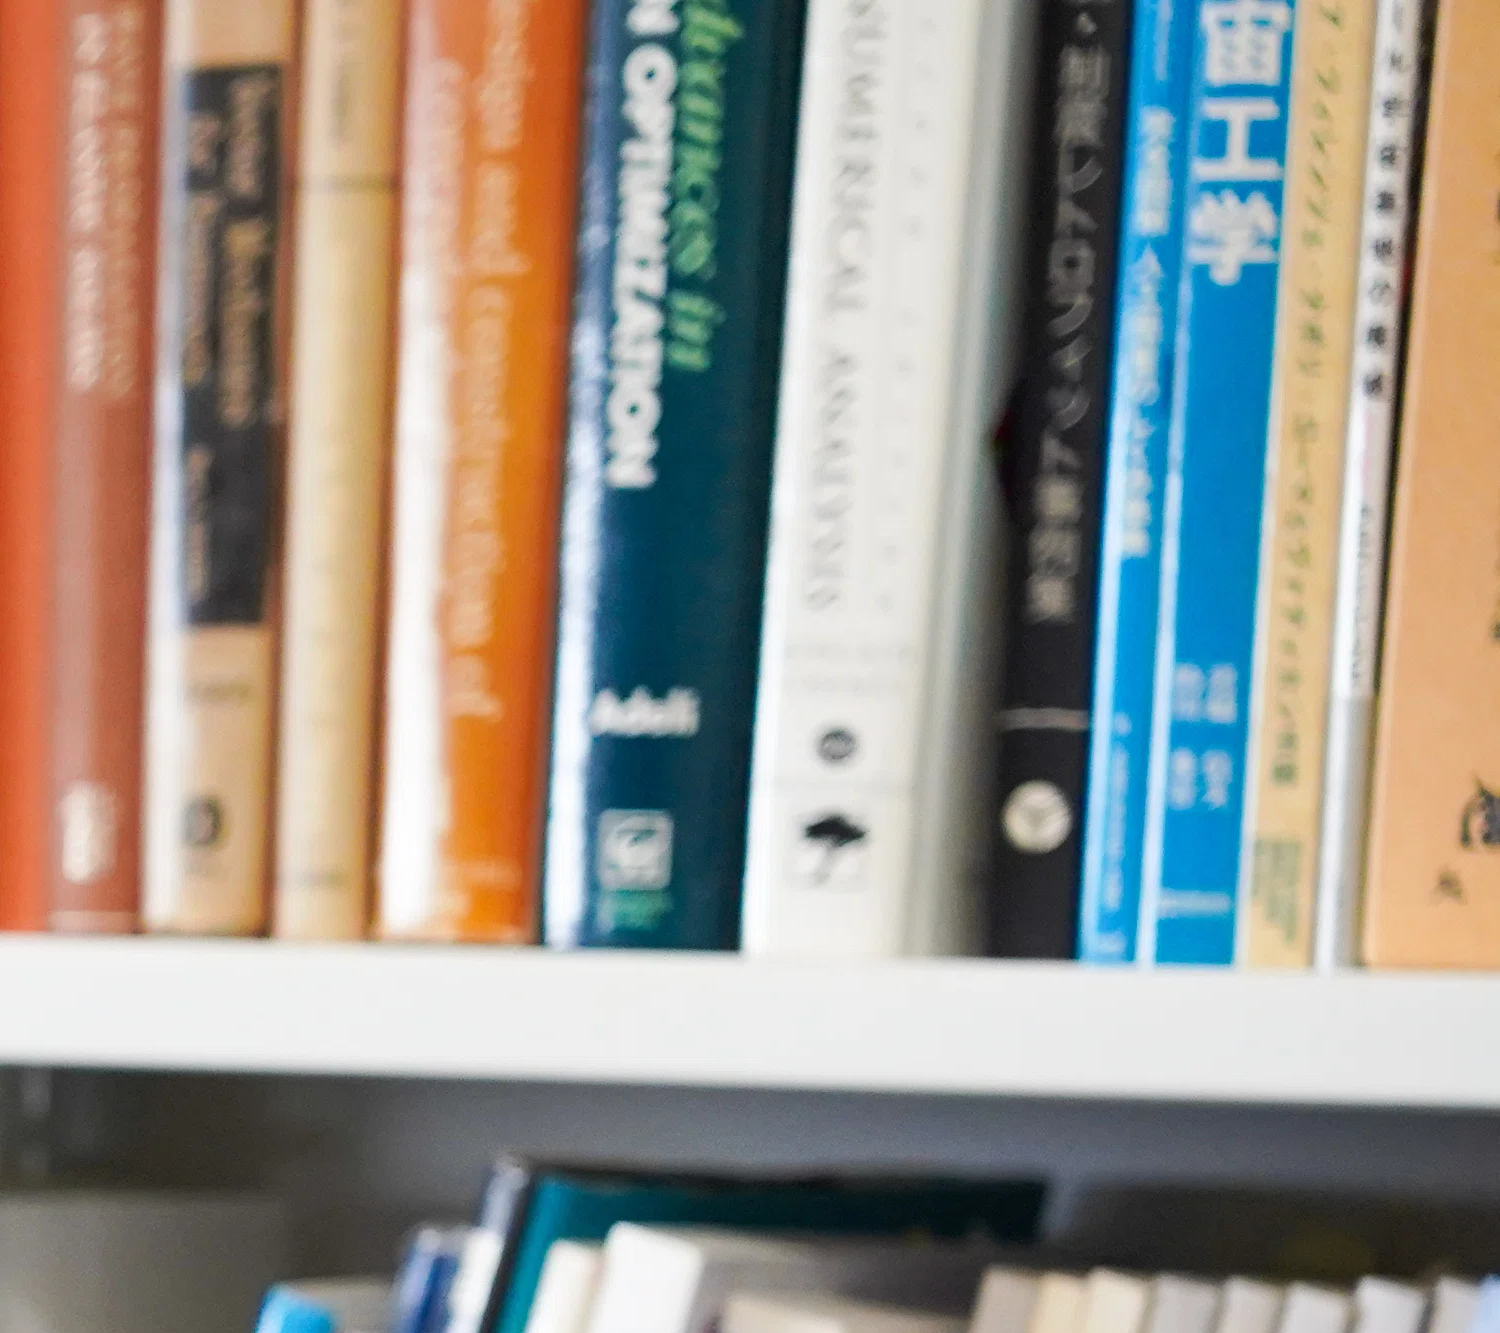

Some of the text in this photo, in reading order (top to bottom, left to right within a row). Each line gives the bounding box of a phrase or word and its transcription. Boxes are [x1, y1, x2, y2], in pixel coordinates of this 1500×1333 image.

[604, 42, 680, 490] OPTIMIZATION
[660, 0, 746, 371] dvances in
